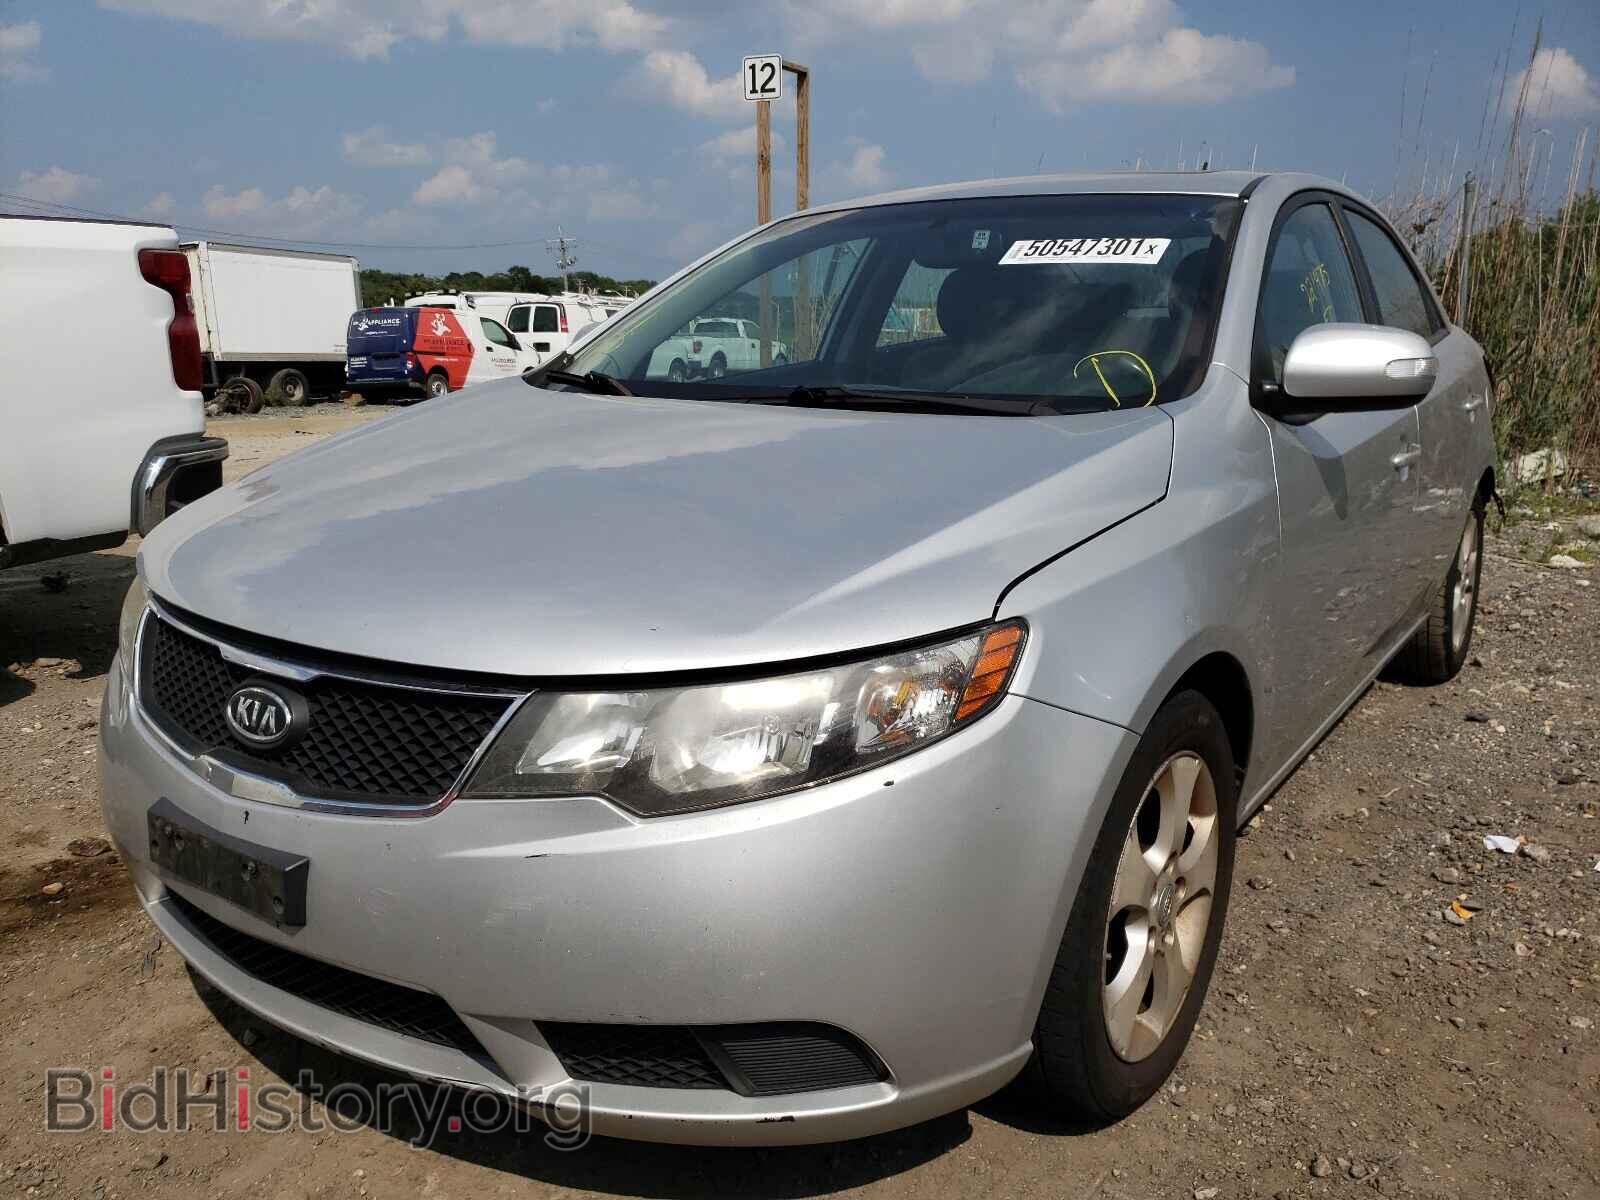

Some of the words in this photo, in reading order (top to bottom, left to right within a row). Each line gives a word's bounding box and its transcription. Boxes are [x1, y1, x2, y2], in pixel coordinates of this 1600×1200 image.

[748, 62, 776, 94] 12
[1023, 239, 1142, 257] 50547301
[235, 696, 276, 736] KIA
